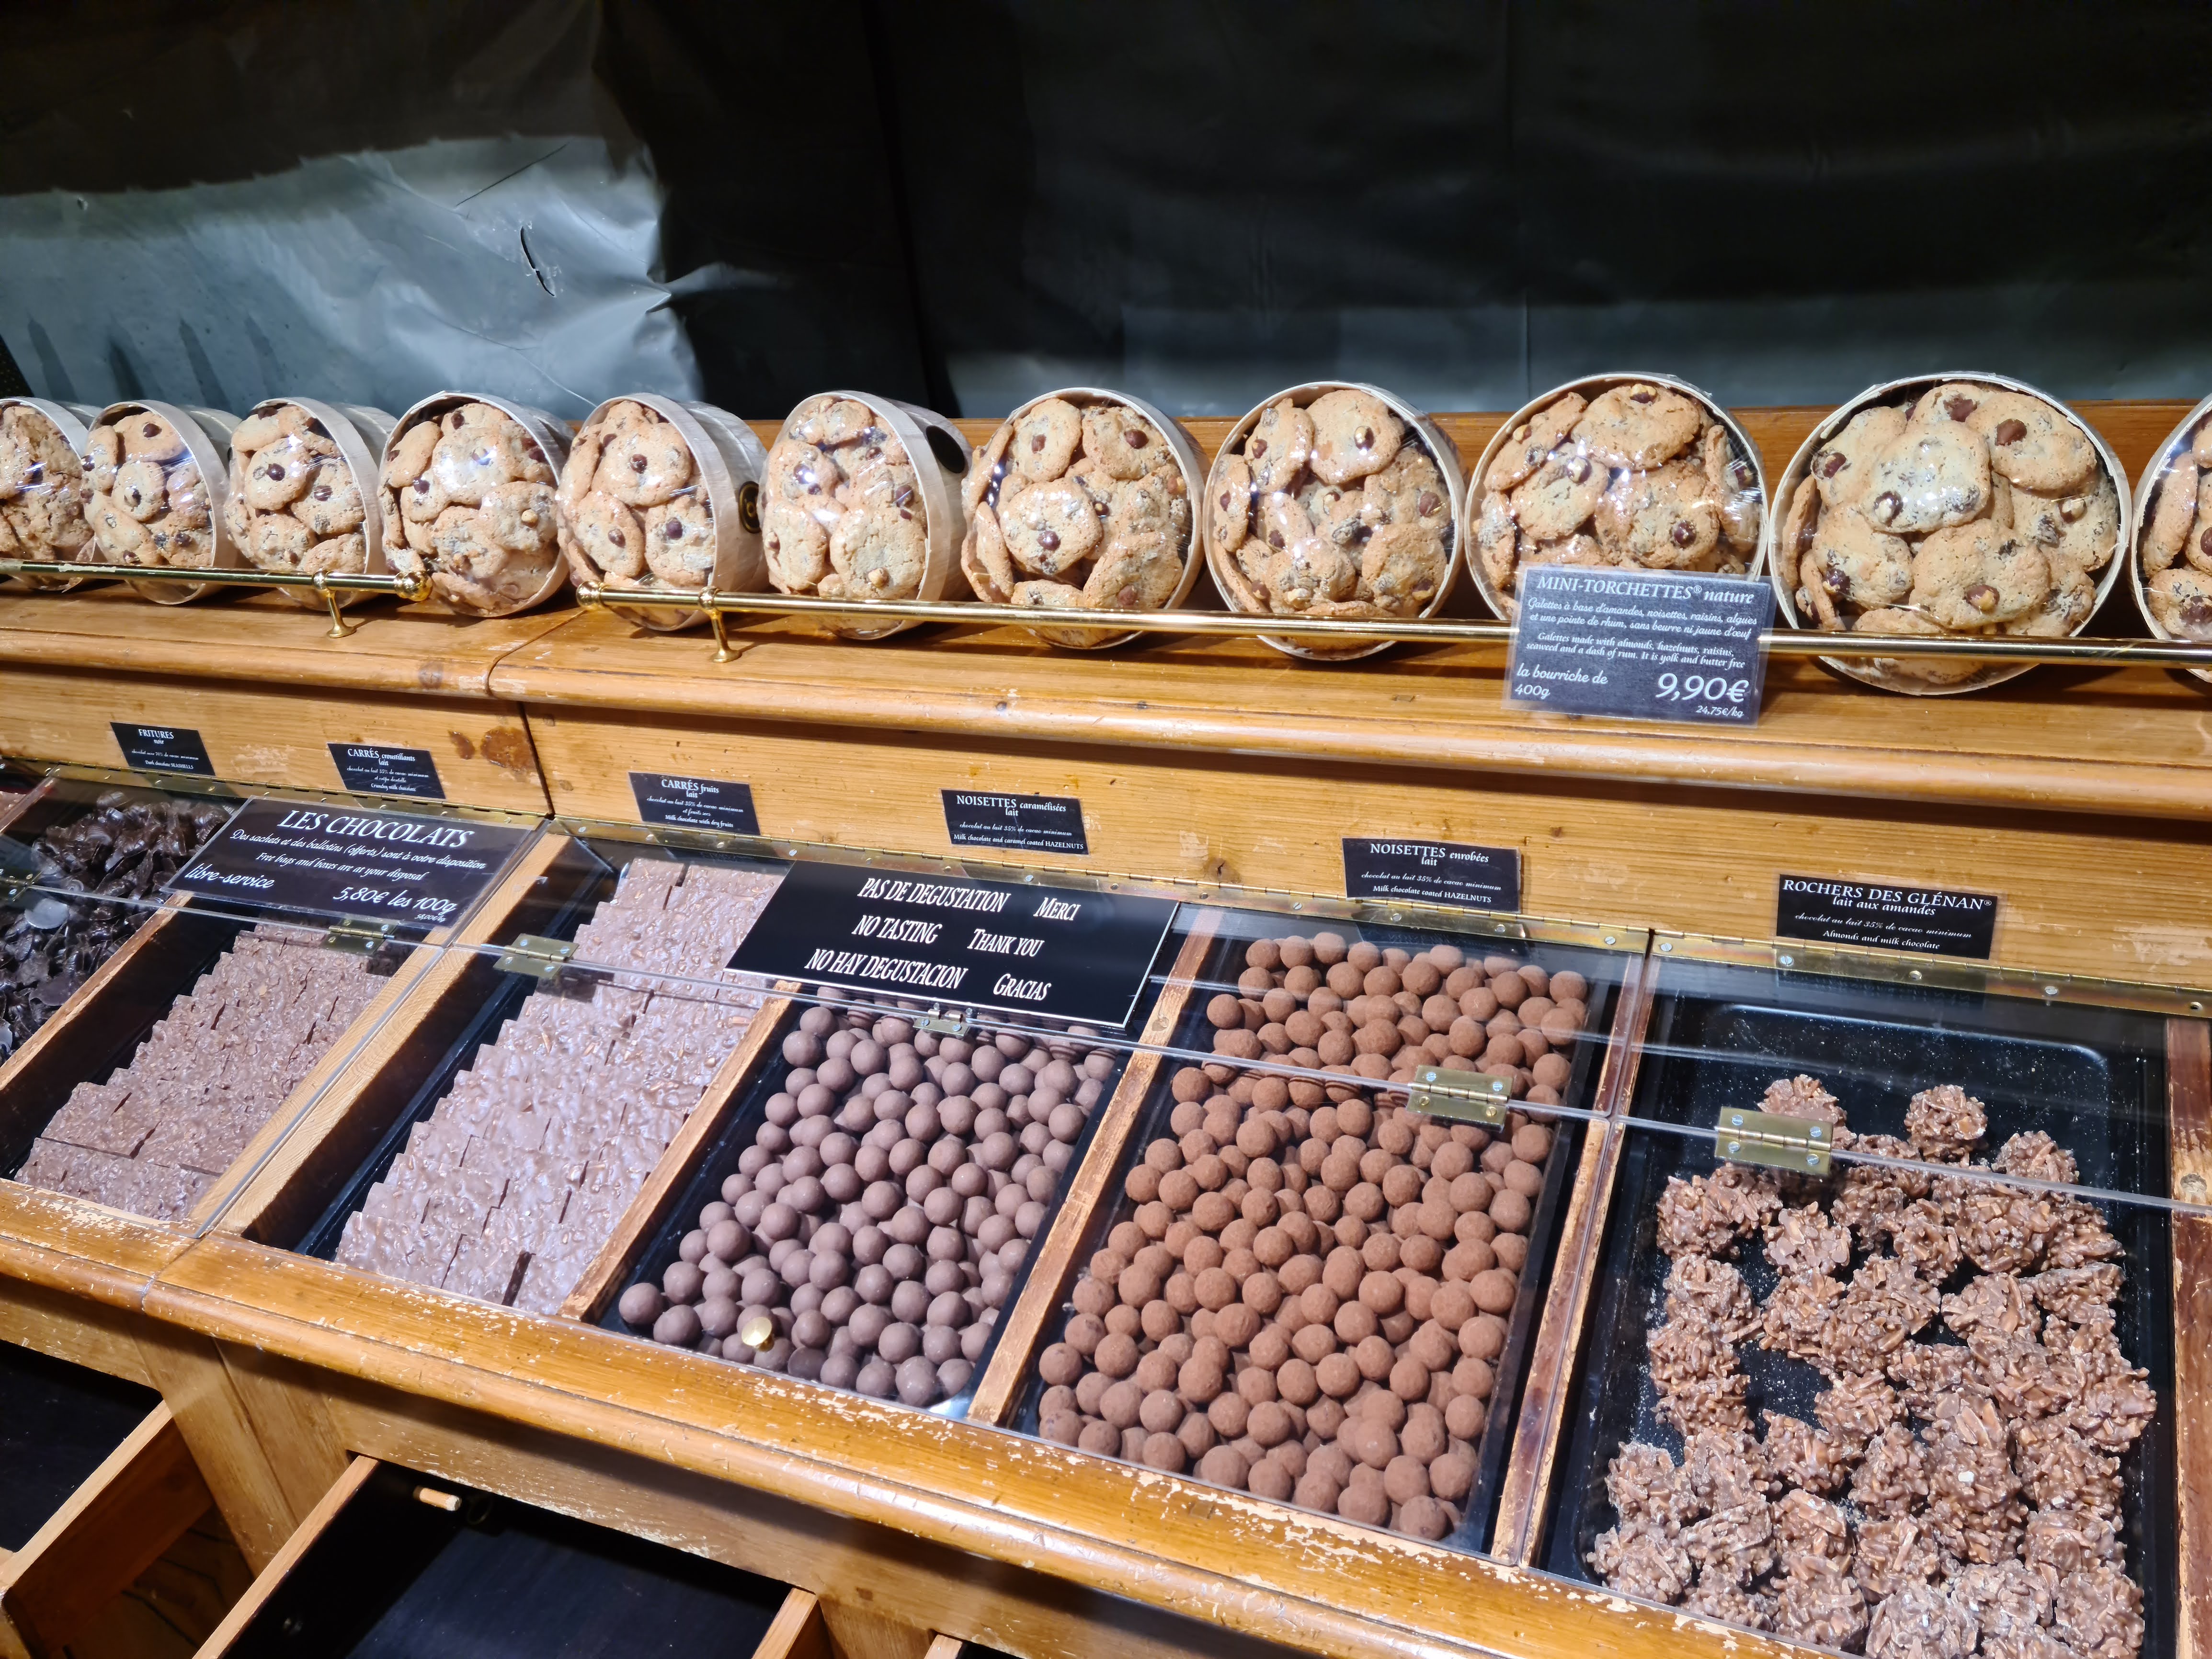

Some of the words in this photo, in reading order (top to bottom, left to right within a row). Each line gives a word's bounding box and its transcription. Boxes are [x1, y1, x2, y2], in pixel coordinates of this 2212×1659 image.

[1703, 591, 1755, 603] nature
[1528, 597, 1562, 610] Galettes
[1564, 602, 1571, 610] à
[1573, 601, 1594, 612] base
[1596, 602, 1644, 617] d'amandes,
[1647, 610, 1688, 620] noisettes,
[1690, 613, 1723, 623] raisins,
[1726, 613, 1757, 626] algues
[1557, 616, 1586, 625] pointe
[1587, 615, 1598, 625] de
[1600, 616, 1627, 628] rhum,
[1653, 620, 1682, 632] beurre
[1684, 625, 1694, 633] ni
[1693, 626, 1722, 636] jaune
[1538, 632, 1570, 642] Galettes
[1572, 635, 1594, 644] made
[1596, 637, 1615, 646] with
[1618, 638, 1654, 649] almonds,
[1657, 641, 1699, 654] hazelnuts,
[1703, 647, 1734, 657] raisins,
[1526, 643, 1561, 651] seaweed
[1560, 644, 1579, 653] and
[1586, 646, 1605, 655] dash
[1608, 648, 1618, 659] of
[1659, 653, 1679, 664] yolk
[1681, 655, 1700, 664] and
[1700, 655, 1727, 666] butter
[1724, 658, 1745, 670] free
[1516, 663, 1530, 678] la
[1533, 665, 1589, 682] bourriche
[1588, 670, 1608, 685] de
[1515, 684, 1550, 699] 400g
[1655, 672, 1749, 703] 9,90€
[1696, 705, 1744, 718] 24,75€/kg
[138, 728, 174, 739] FRITURES
[348, 748, 379, 758] CARRÉS
[382, 753, 415, 761] croustillants
[661, 779, 699, 791] CARRÉS
[699, 784, 719, 795] fruits
[686, 790, 698, 798] lait
[956, 795, 1016, 808] NOISETTES
[1020, 802, 1066, 812] caramélisées
[1005, 807, 1019, 816] lait
[276, 810, 329, 830] LES
[326, 816, 475, 847] CHOCOLATS
[711, 819, 719, 828] dry
[719, 819, 733, 828] fruits
[230, 829, 249, 840] Des
[250, 833, 280, 845] sachets
[290, 837, 306, 848] des
[306, 837, 342, 852] ballotins
[343, 843, 383, 857] (offerts)
[381, 851, 403, 859] sont
[402, 852, 410, 860] à
[411, 854, 436, 863] votre
[436, 854, 486, 869] disposition
[1045, 841, 1084, 849] HAZELNUTS
[1370, 843, 1446, 858] NOISETTES
[1449, 851, 1489, 863] enrobées
[256, 852, 274, 862] Free
[274, 852, 296, 867] bags
[295, 858, 315, 866] and
[315, 858, 337, 870] boxes
[337, 864, 354, 872] are
[360, 868, 387, 877] your
[387, 868, 430, 881] disposal
[1421, 855, 1438, 866] lait
[184, 863, 275, 888] libre-service
[1361, 871, 1390, 879] chocolat
[1402, 873, 1416, 881] lait
[1465, 882, 1502, 891] minimum
[857, 877, 890, 899] PAS
[884, 882, 909, 902] DE
[906, 884, 1010, 913] DEGUSTATION
[1390, 886, 1420, 895] chocolate
[1444, 891, 1492, 903] HAZELNUTS
[1782, 879, 1863, 898] ROCHERS
[1868, 888, 1903, 902] DES
[333, 886, 389, 903] 5,80€
[388, 889, 413, 908] les
[412, 897, 457, 916] 100g
[1832, 896, 1854, 908] lait
[1856, 901, 1880, 910] aux
[1882, 903, 1937, 916] amandes
[851, 914, 880, 936] NO
[880, 918, 942, 944] TASTING
[1794, 912, 1831, 922] chocolat
[1845, 916, 1862, 926] lait
[1863, 920, 1883, 929] 35%
[1885, 922, 1896, 931] de
[1926, 928, 1972, 938] minimum
[1823, 930, 1859, 941] Almonds
[1861, 934, 1880, 943] and
[1880, 936, 1900, 945] milk
[1901, 939, 1940, 950] chocolate
[804, 948, 835, 972] NO
[829, 951, 865, 975] HAY
[859, 955, 968, 989] DEGUSTACION
